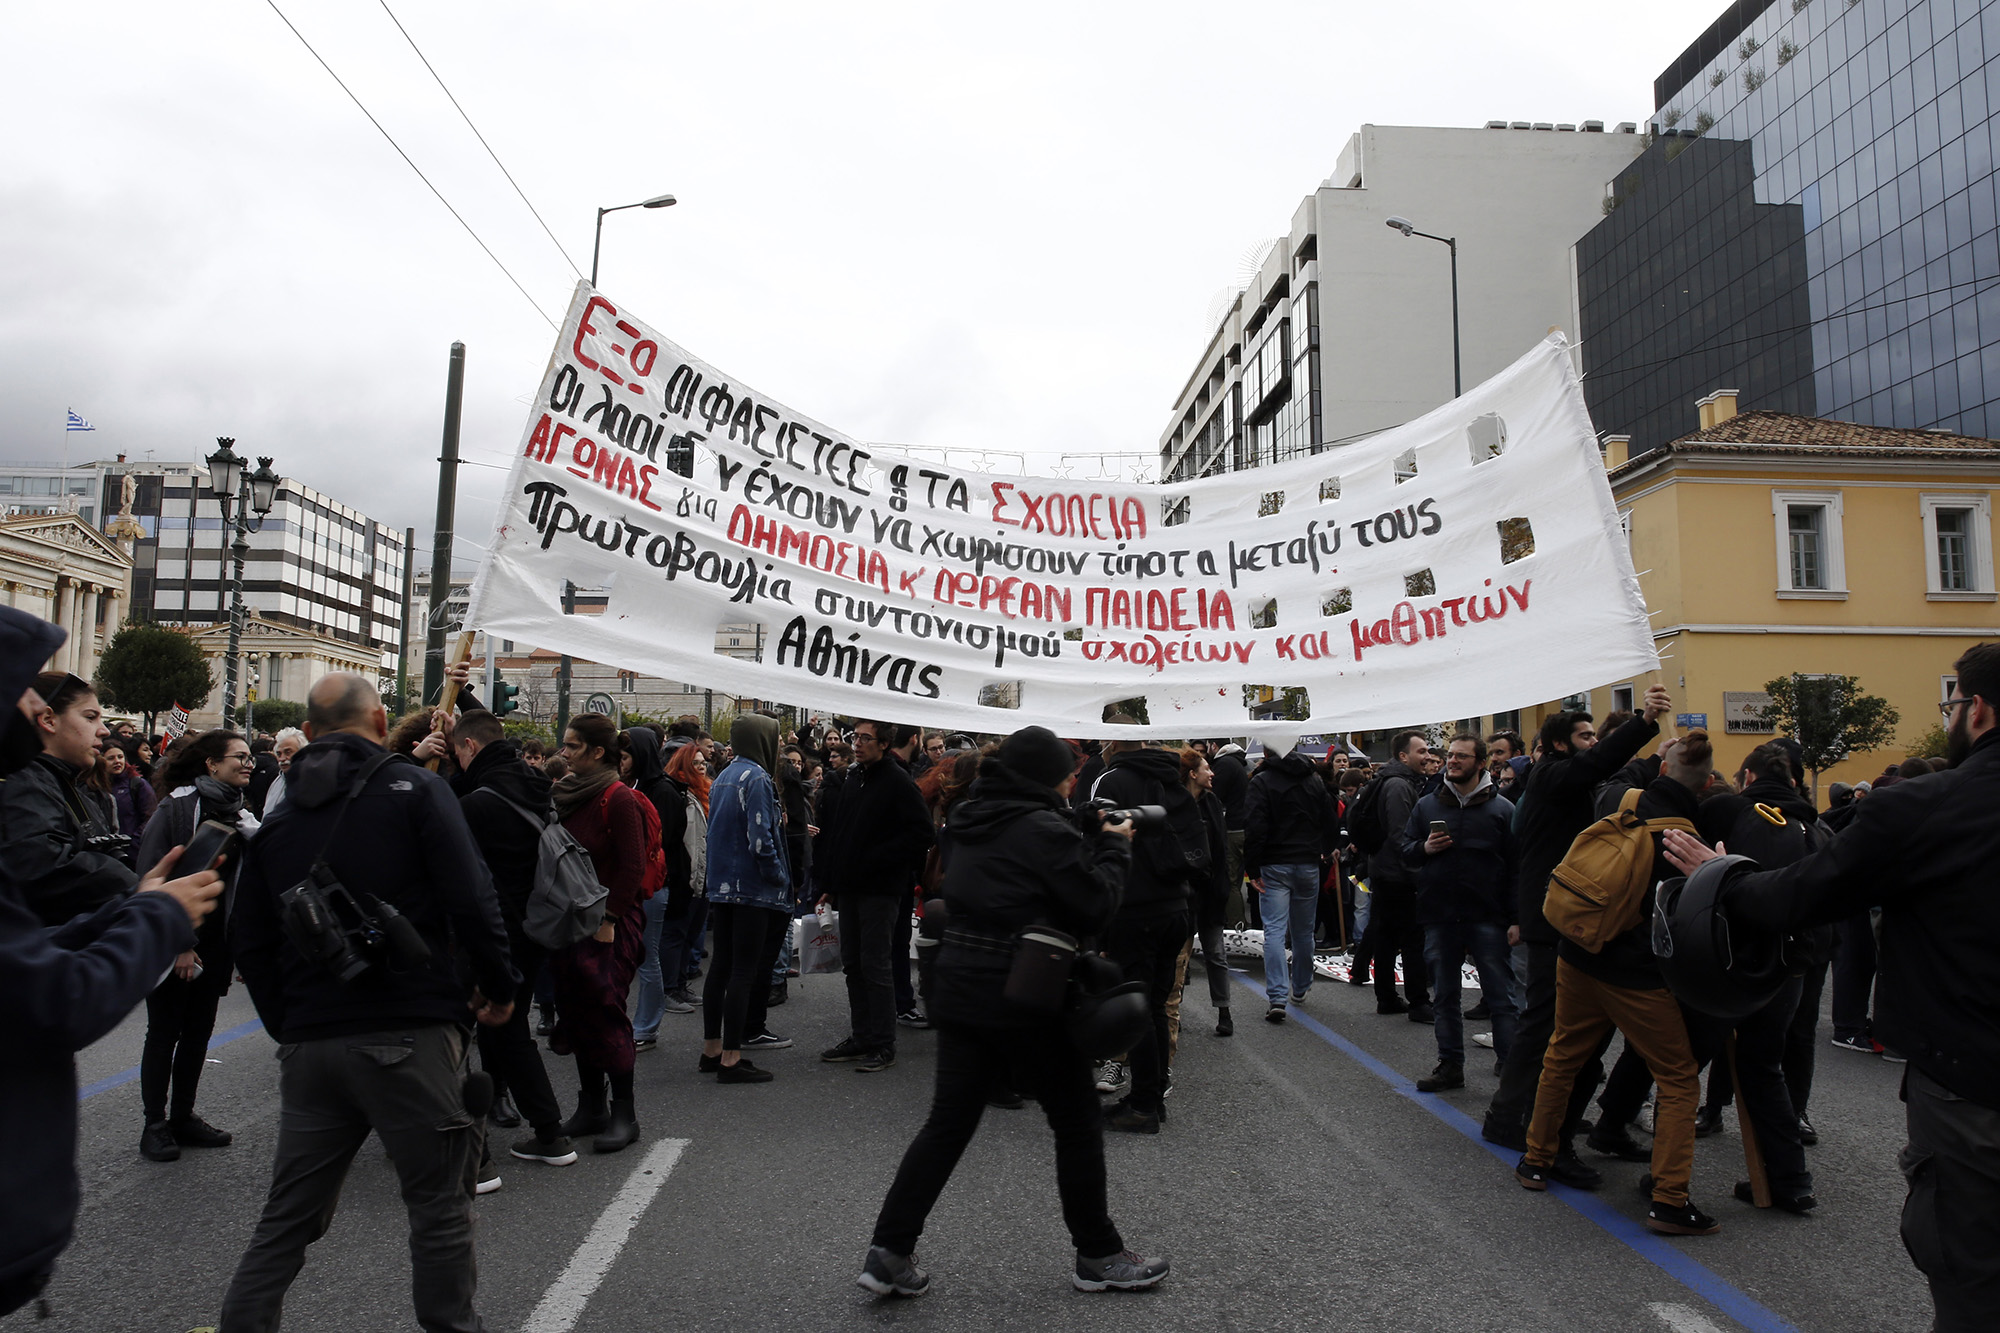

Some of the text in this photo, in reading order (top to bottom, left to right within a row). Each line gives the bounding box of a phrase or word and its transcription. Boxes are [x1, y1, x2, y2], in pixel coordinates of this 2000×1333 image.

[523, 413, 662, 512] ΑΓΩΝΑΣ
[676, 487, 718, 522] για
[727, 504, 890, 594] ΔΗΜΟΣΙΑ
[933, 568, 1072, 622] ΔΩΡΕΑΝ
[1086, 588, 1236, 631] ΠΑΙΔΕΙΑ
[919, 470, 970, 514] ΤΑ
[990, 482, 1147, 540] ΣΧΟΛΕΙΑ
[523, 481, 1532, 672] Πρωτοβουλία συντονισμού σχολείων και μαθητών
[870, 509, 913, 553] να
[920, 525, 1090, 577] χωρίσουν
[1228, 520, 1341, 589] μεταξύ
[776, 615, 944, 700] Αθήνας
